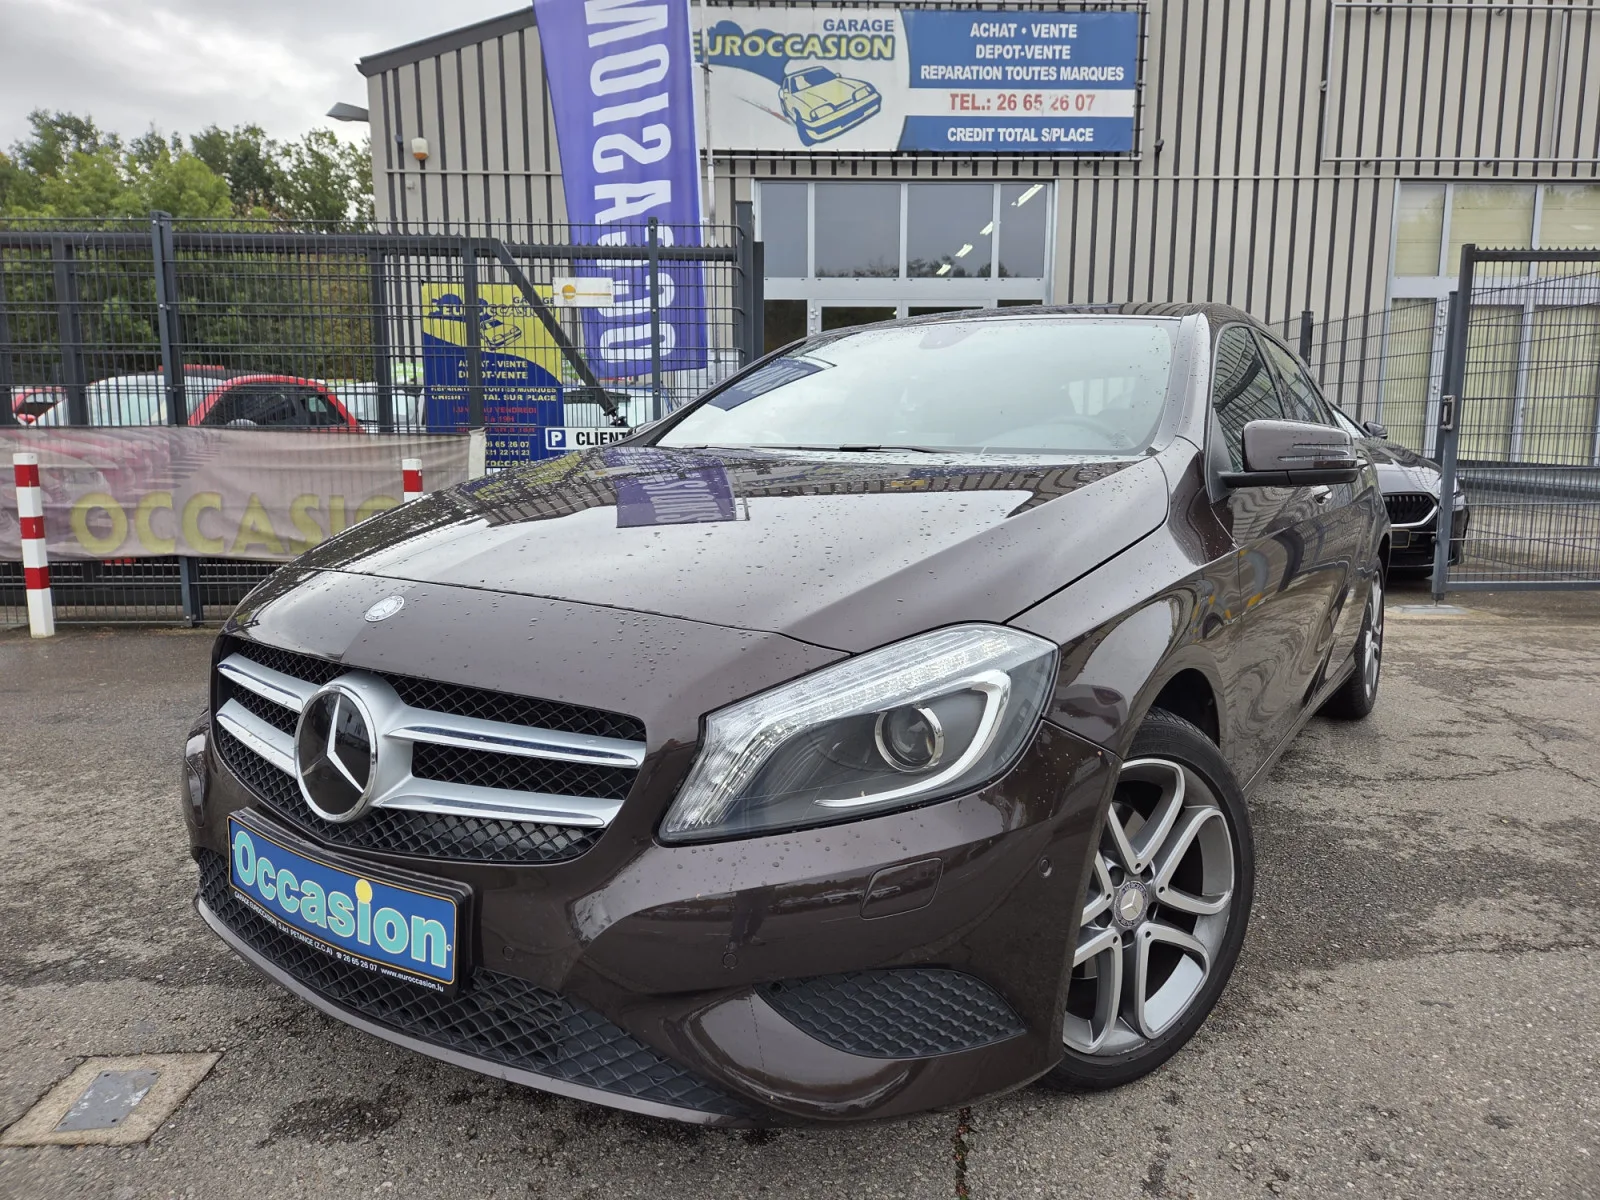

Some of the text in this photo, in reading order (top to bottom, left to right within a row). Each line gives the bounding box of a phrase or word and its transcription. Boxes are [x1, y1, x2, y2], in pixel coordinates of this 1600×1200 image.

[823, 19, 894, 32] GARAGE
[970, 23, 1078, 38] ACHAT VENTE
[976, 44, 1071, 60] DEPOT-VENTE
[920, 65, 1124, 82] REPARATION TOUTES MARQUES
[950, 93, 1096, 111] TEL.: 26 65 26 07
[947, 127, 1094, 142] CREDIT TOTAL S/PLACE
[233, 830, 447, 969] Occasion
[380, 967, 445, 993] www.euroccasion.lu
